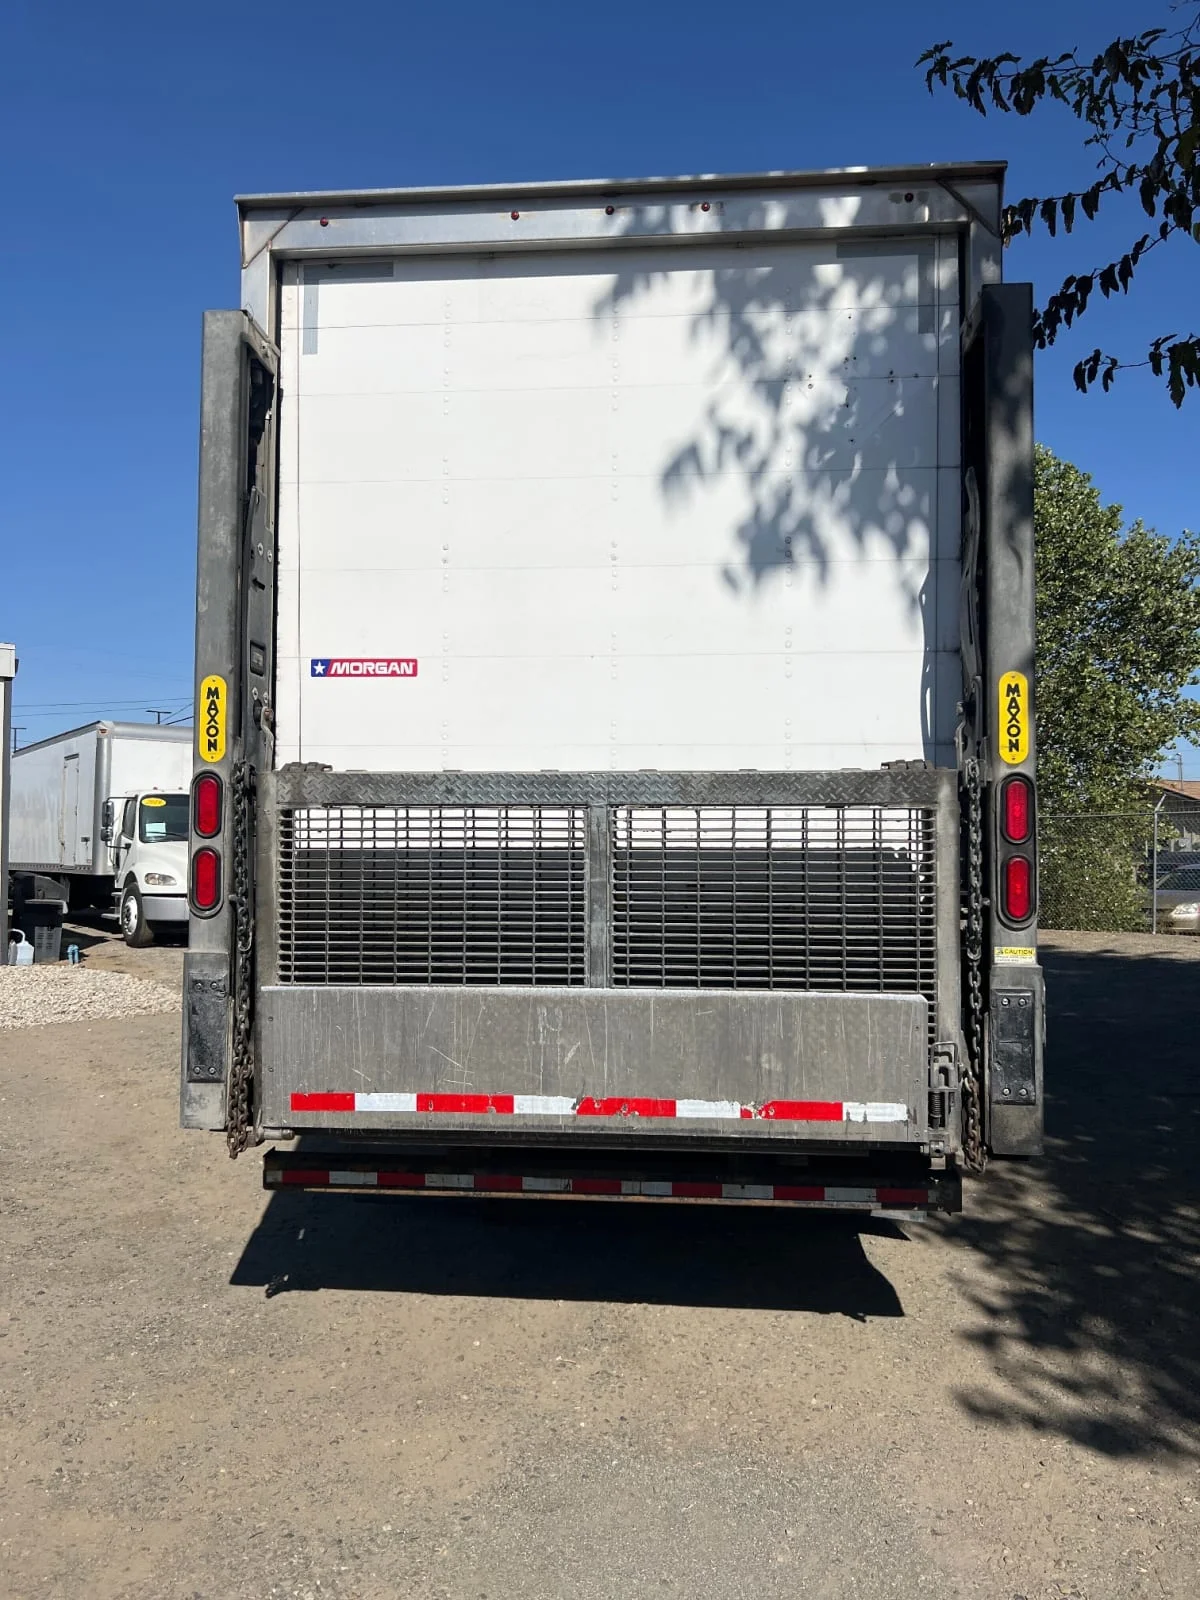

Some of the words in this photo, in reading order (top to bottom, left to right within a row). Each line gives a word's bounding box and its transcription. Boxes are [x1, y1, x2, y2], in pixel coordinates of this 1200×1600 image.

[330, 661, 415, 675] MORGAN
[206, 686, 220, 752] MAXON
[1005, 683, 1021, 753] MAXON
